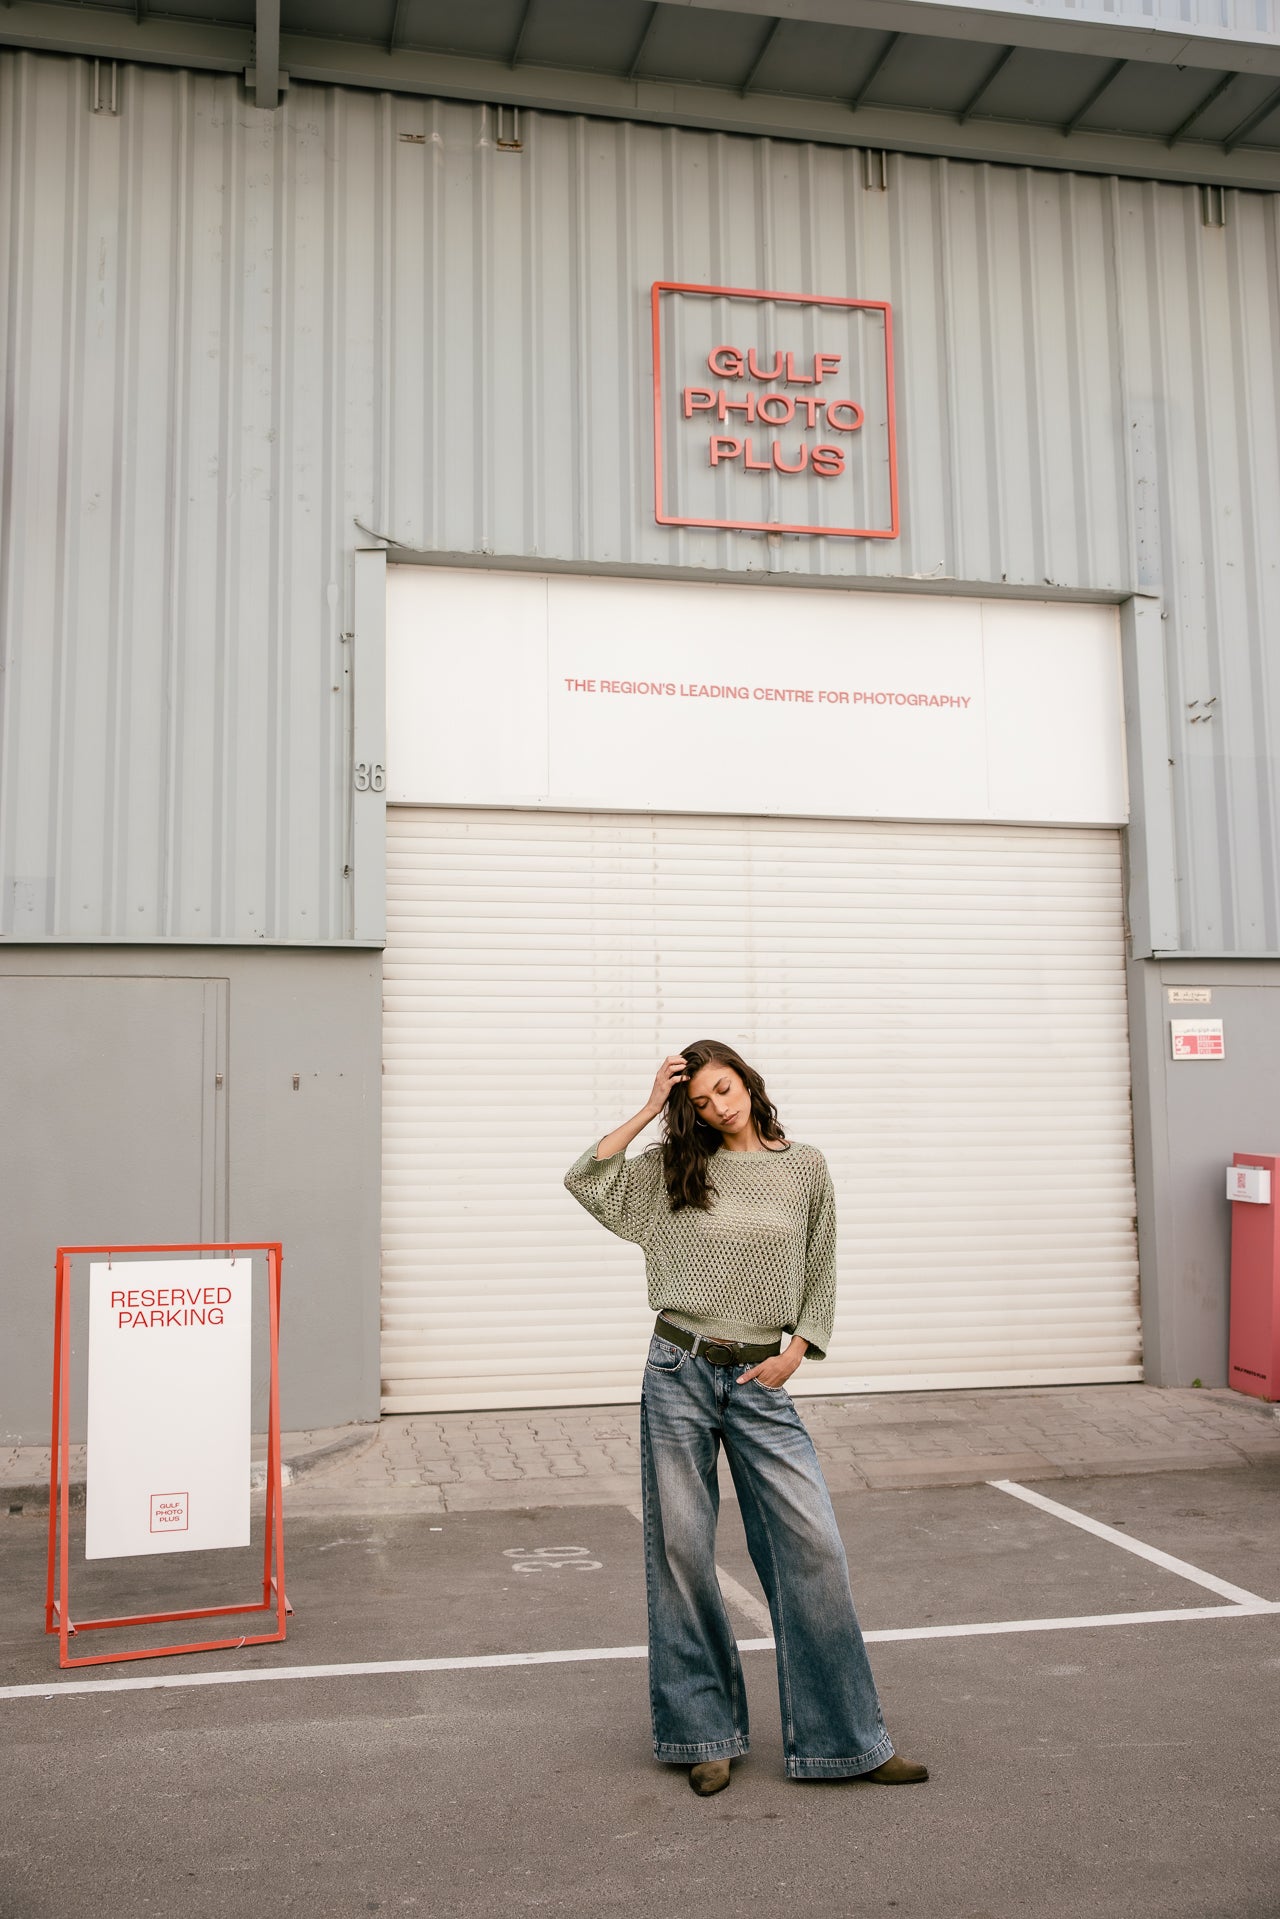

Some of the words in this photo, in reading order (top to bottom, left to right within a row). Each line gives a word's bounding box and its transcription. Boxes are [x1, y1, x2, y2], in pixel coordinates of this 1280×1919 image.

[708, 345, 842, 385] GULF
[683, 387, 865, 432] PHOTO
[709, 435, 846, 477] PLUS
[565, 678, 596, 693] THE
[600, 680, 676, 697] REGION'S
[680, 684, 750, 701] LEADING
[753, 687, 814, 704] CENTRE
[818, 690, 850, 705] FOR
[853, 692, 971, 710] PHOTOGRAPHY
[354, 761, 386, 793] 36
[111, 1287, 232, 1309] RESERVED
[118, 1307, 224, 1329] PARKING
[155, 1508, 184, 1516] PHOTO
[502, 1546, 604, 1573] 36
